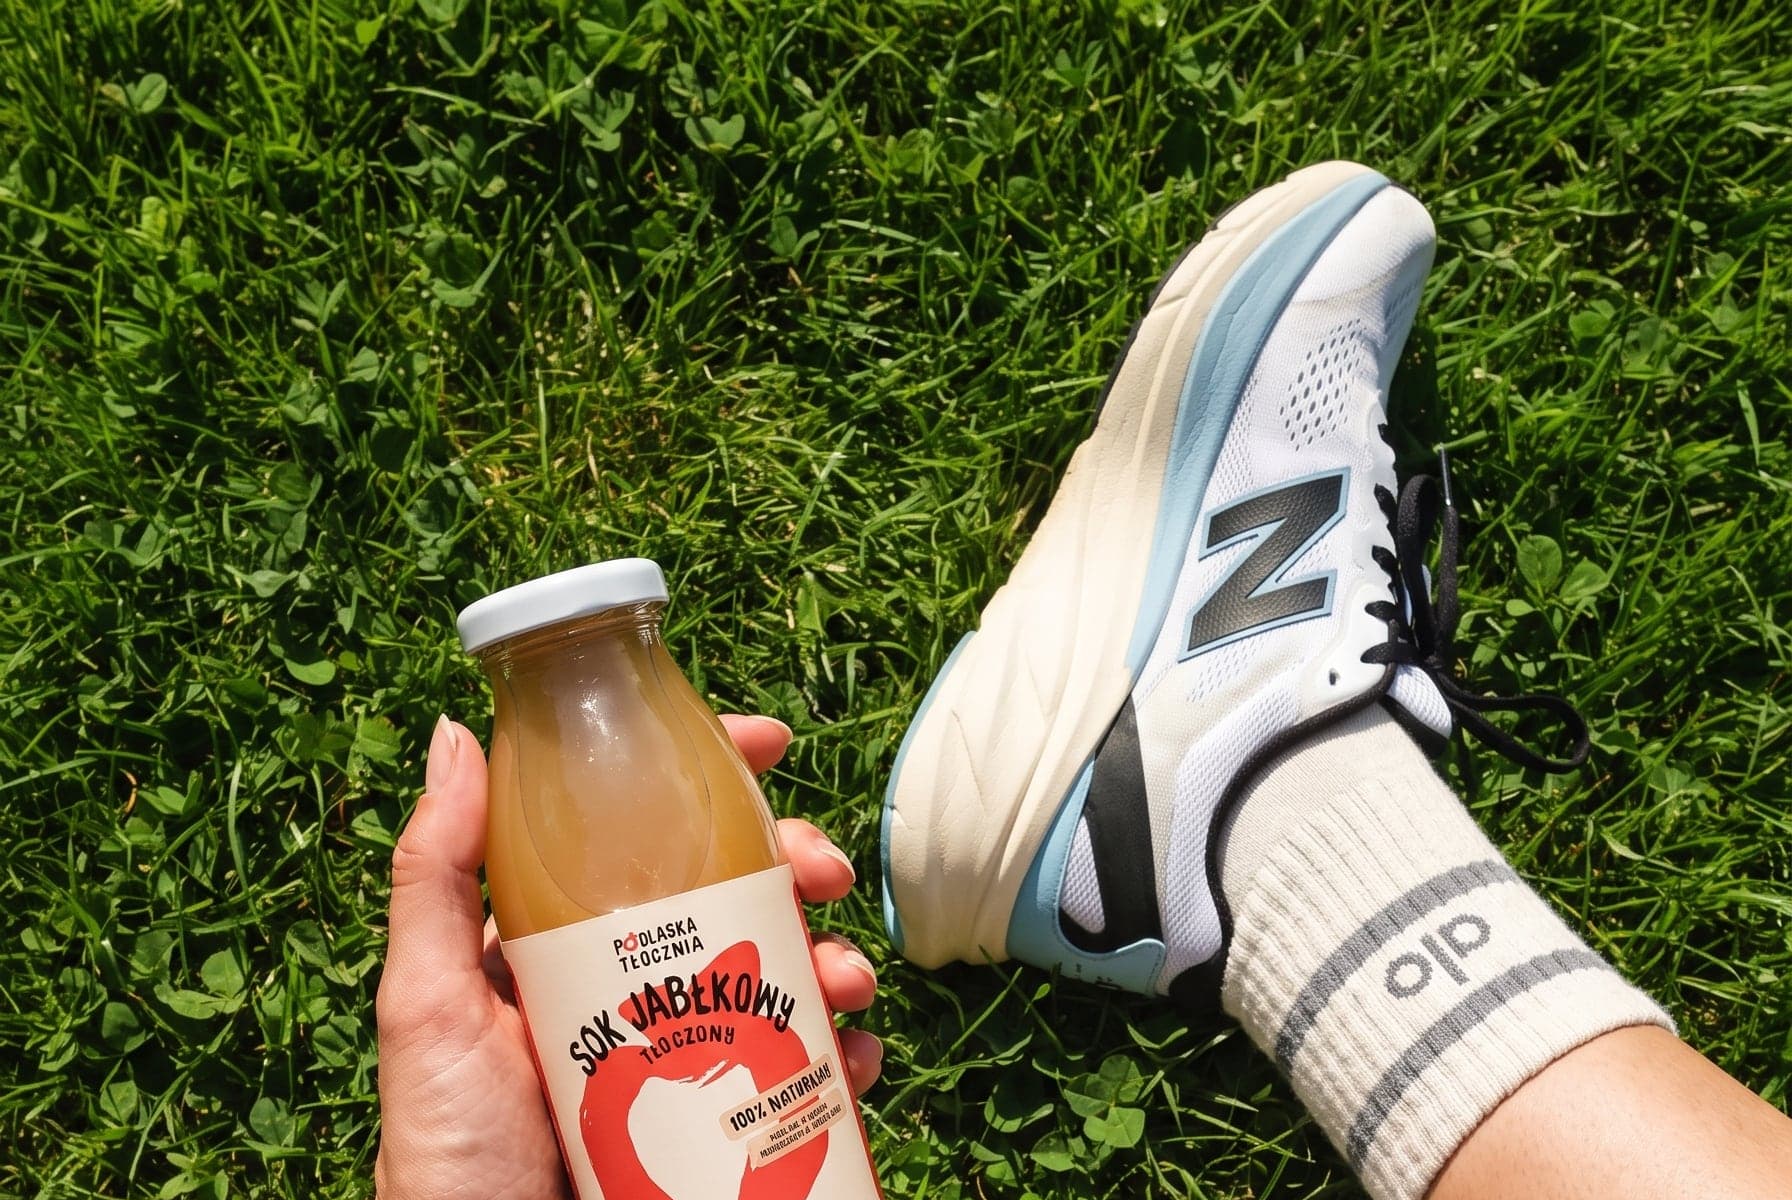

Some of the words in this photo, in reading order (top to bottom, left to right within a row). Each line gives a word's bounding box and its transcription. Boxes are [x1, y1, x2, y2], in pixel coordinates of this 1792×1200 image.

[1183, 470, 1347, 657] N
[613, 917, 698, 956] PODLASKA
[619, 936, 704, 973] TŁOCZNIA
[1384, 913, 1491, 1000] alo
[569, 1010, 627, 1077] SOK
[629, 970, 795, 1033] JABŁKOWY
[640, 1025, 735, 1064] TŁOCZONY
[729, 1102, 767, 1132] 100%
